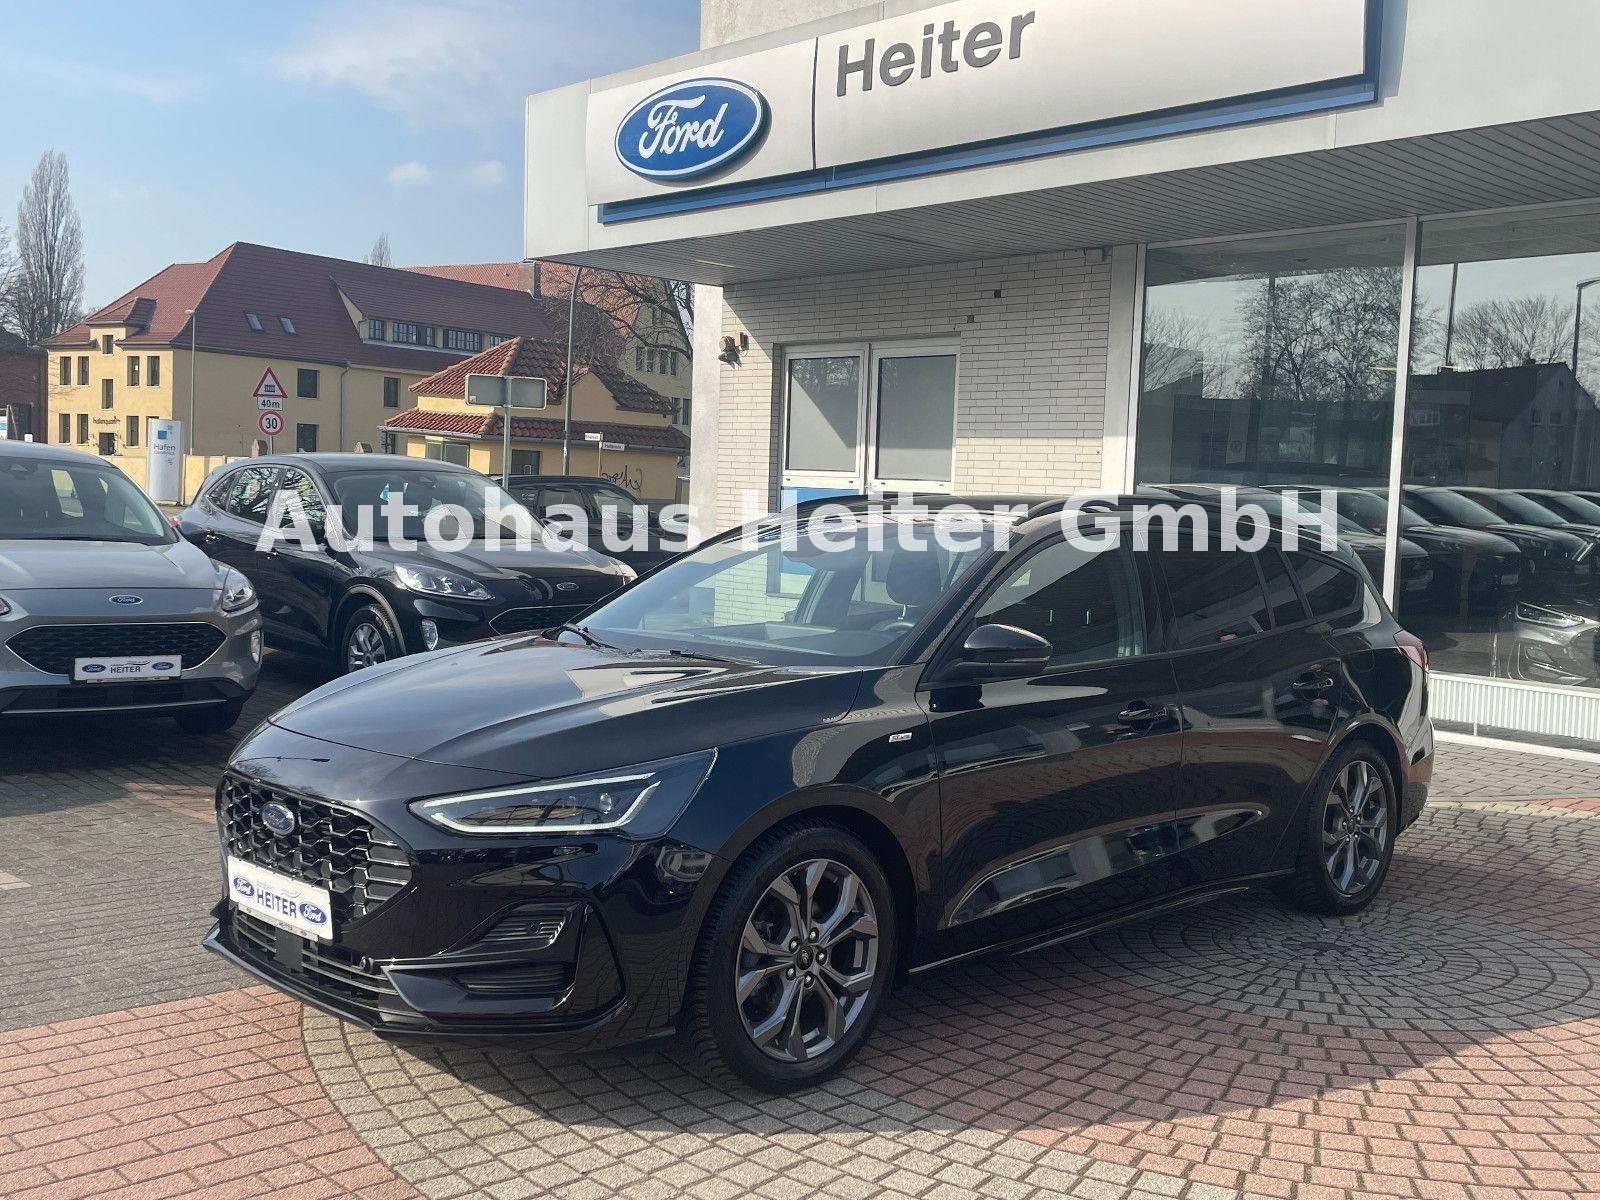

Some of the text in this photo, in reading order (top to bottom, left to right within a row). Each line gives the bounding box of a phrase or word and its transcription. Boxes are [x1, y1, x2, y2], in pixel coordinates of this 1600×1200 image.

[836, 10, 1035, 98] Heiter
[637, 94, 730, 160] Ford
[265, 417, 278, 429] 30
[153, 443, 176, 452] Hafen
[110, 665, 141, 674] HEITER
[236, 876, 253, 896] Ford
[256, 887, 297, 919] HEITER
[303, 903, 323, 922] Ford
